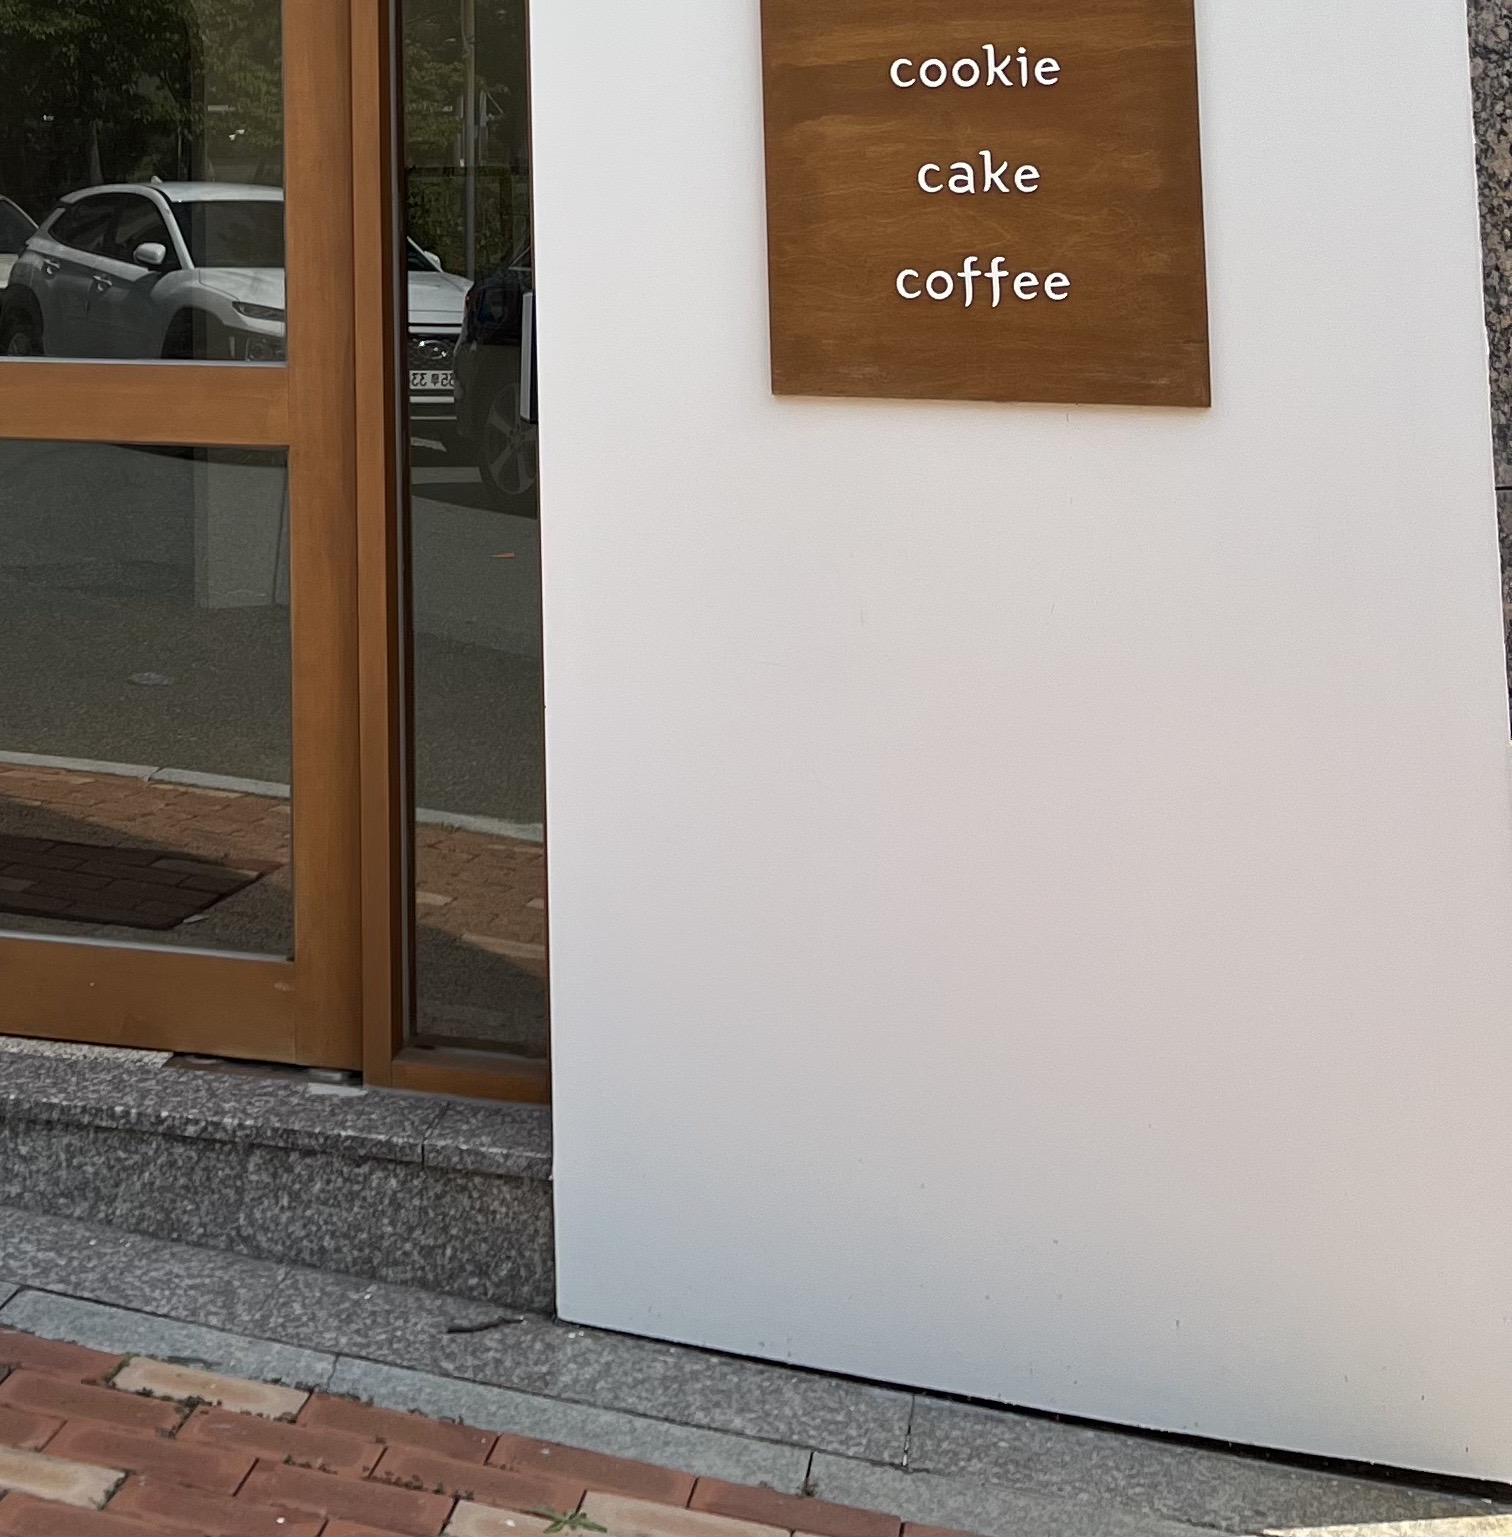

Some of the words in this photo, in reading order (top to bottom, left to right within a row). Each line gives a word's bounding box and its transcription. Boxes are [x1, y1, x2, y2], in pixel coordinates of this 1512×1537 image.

[890, 43, 1061, 88] cookie
[917, 149, 1041, 194] cake
[896, 255, 1071, 308] coffee
